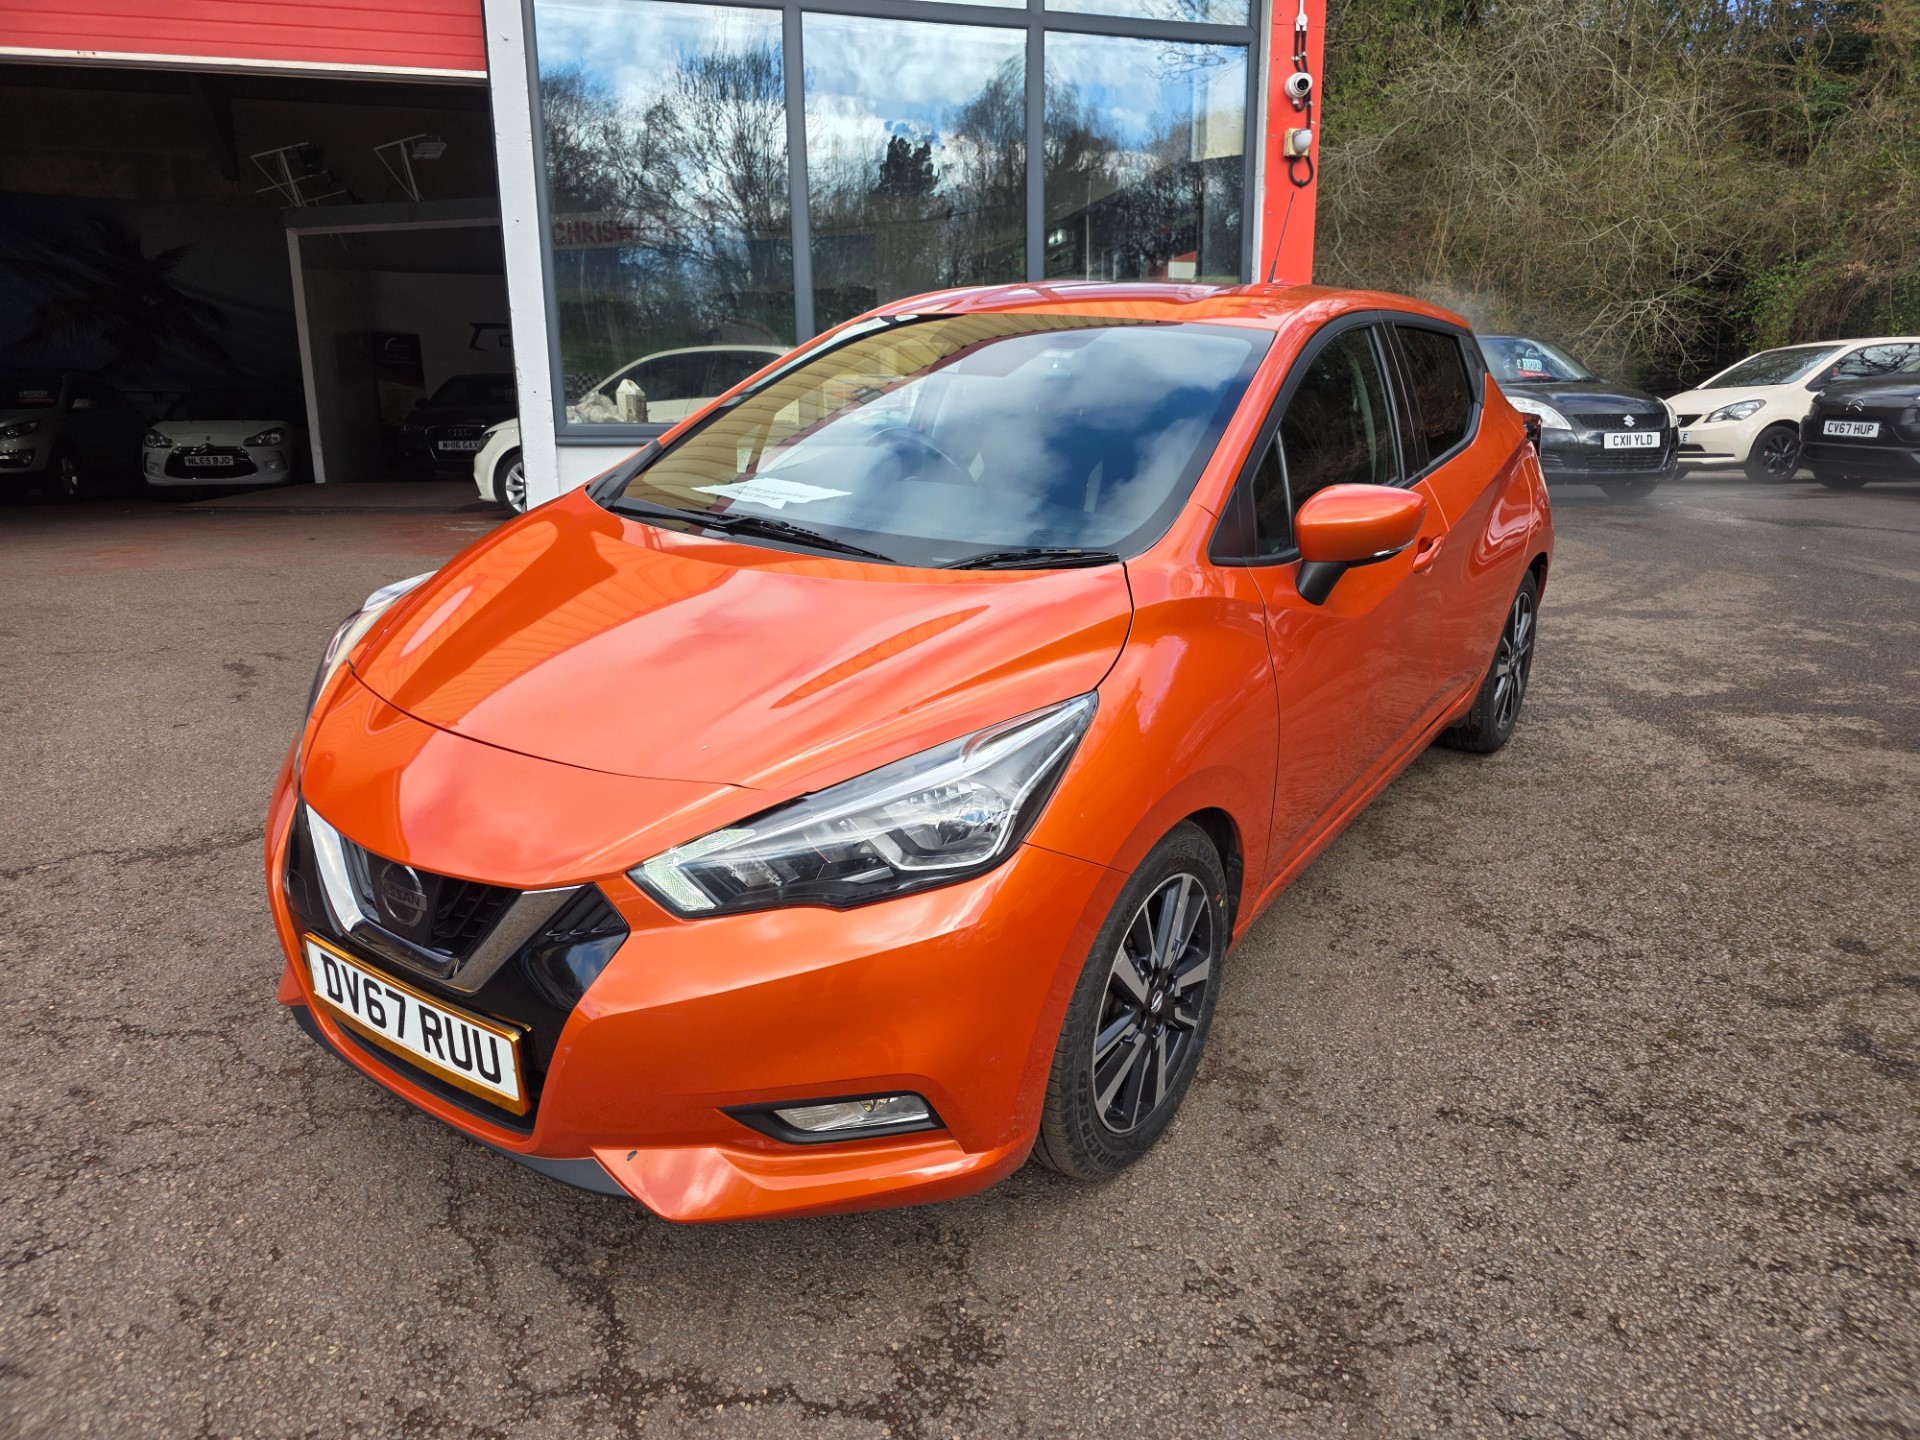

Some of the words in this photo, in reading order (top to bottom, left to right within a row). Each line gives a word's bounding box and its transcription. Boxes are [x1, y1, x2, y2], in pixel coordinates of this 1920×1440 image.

[1828, 422, 1851, 433] CV67
[1853, 424, 1874, 435] HUP
[1613, 435, 1631, 446] CX11
[1634, 435, 1652, 446] YLD
[188, 457, 210, 465] NL65
[381, 881, 420, 906] NISSAN
[320, 953, 406, 1040] DV67
[418, 1004, 502, 1085] RUU
